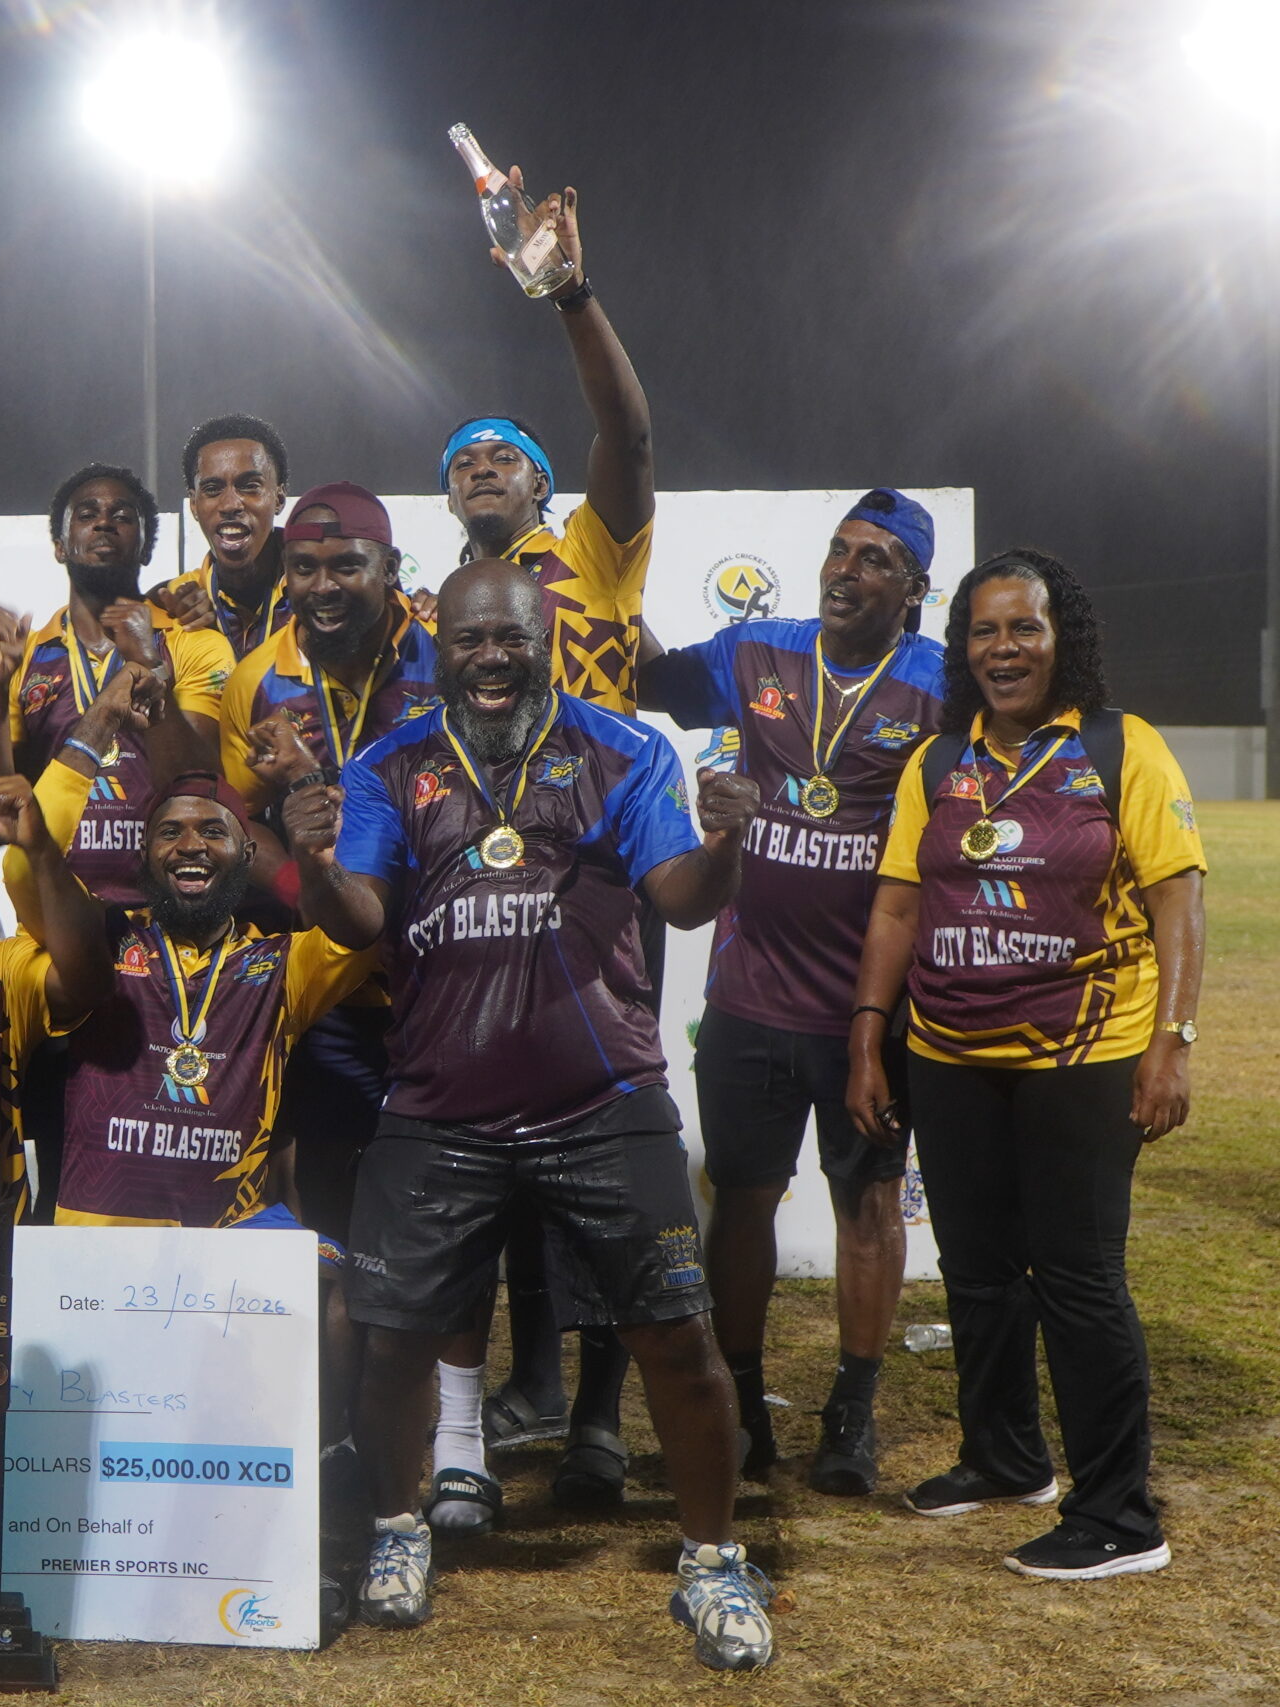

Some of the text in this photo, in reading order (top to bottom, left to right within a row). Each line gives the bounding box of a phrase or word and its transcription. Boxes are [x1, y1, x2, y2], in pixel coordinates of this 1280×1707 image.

[735, 553, 767, 566] CRICKET
[705, 555, 733, 583] NATIONAL
[703, 586, 711, 608] LUCIA
[767, 566, 781, 615] ASSOCIATION
[878, 726, 912, 741] SPL
[767, 823, 878, 871] BLASTERS
[1002, 856, 1046, 866] LOTTERIES
[933, 926, 1076, 967] CITY BLASTERS
[149, 1043, 174, 1055] NATIO
[174, 1107, 205, 1117] Holdings
[108, 1116, 242, 1164] CITY BLASTERS
[0, 1295, 7, 1304] 6
[60, 1295, 104, 1310] Date:
[3, 1456, 92, 1474] DOLLARS
[102, 1456, 292, 1484] $25,000.00 XCD
[8, 1518, 41, 1534] and
[46, 1517, 72, 1534] On
[78, 1518, 132, 1535] Behalf
[137, 1519, 155, 1535] of
[41, 1559, 209, 1575] PREMIER SPORTS INC
[244, 1619, 276, 1628] sports
